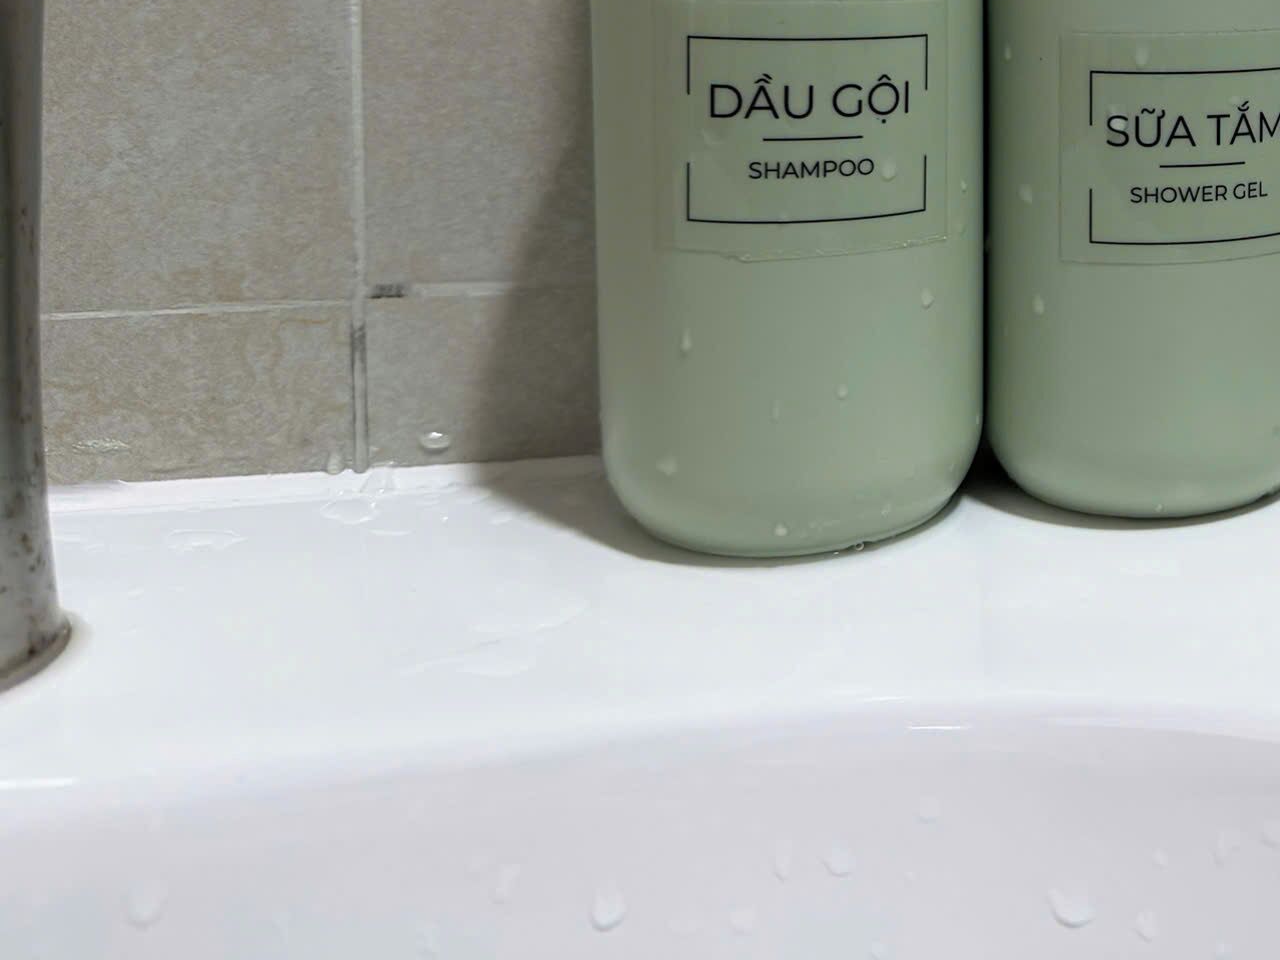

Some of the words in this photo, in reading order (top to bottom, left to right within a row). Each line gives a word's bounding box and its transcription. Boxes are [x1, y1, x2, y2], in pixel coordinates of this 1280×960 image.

[708, 72, 815, 120] DẦU
[832, 73, 910, 125] GỘI
[1105, 107, 1197, 148] SỮA
[747, 157, 875, 180] SHAMPOO
[1129, 184, 1228, 204] SHOWER
[1232, 180, 1269, 201] GEL
